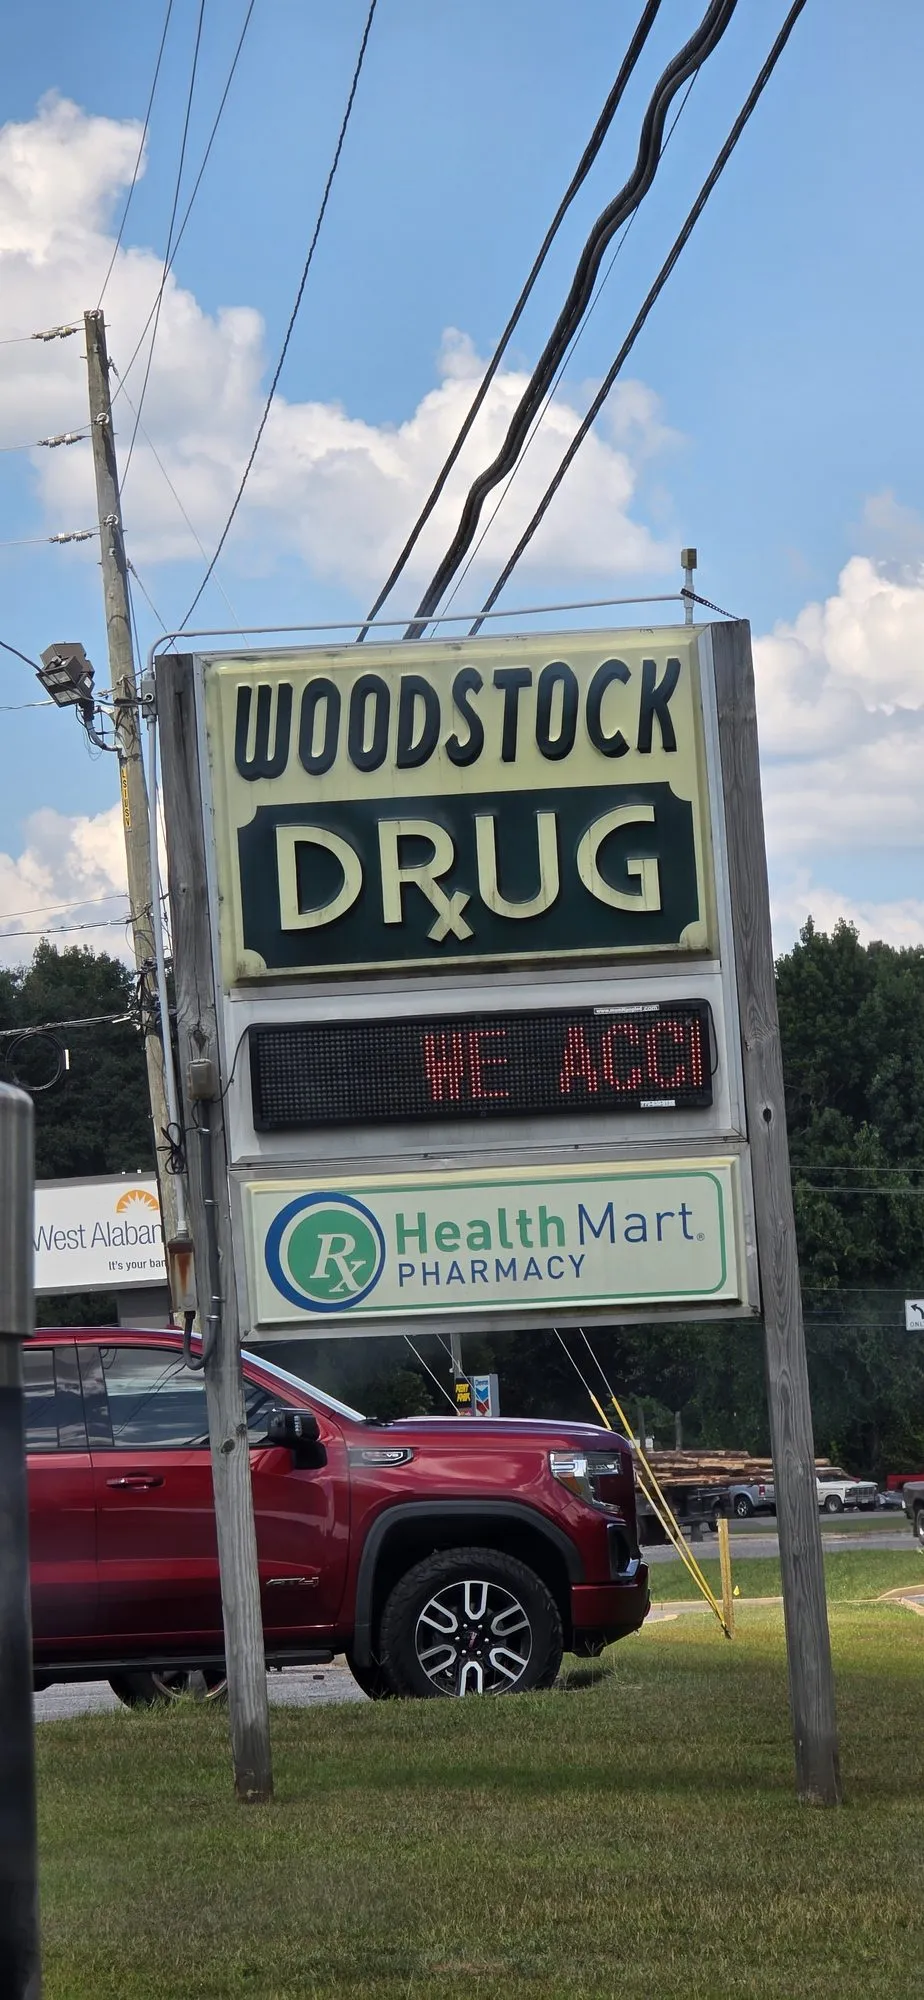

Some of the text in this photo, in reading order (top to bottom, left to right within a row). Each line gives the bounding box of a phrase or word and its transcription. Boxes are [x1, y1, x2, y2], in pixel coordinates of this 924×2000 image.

[235, 657, 681, 781] WOODSTOCK
[422, 1019, 702, 1101] WE ACC
[32, 1224, 87, 1252] West
[395, 1205, 566, 1255] Health
[108, 1260, 124, 1271] It's
[125, 1260, 147, 1271] your
[398, 1254, 585, 1288] PHARMACY
